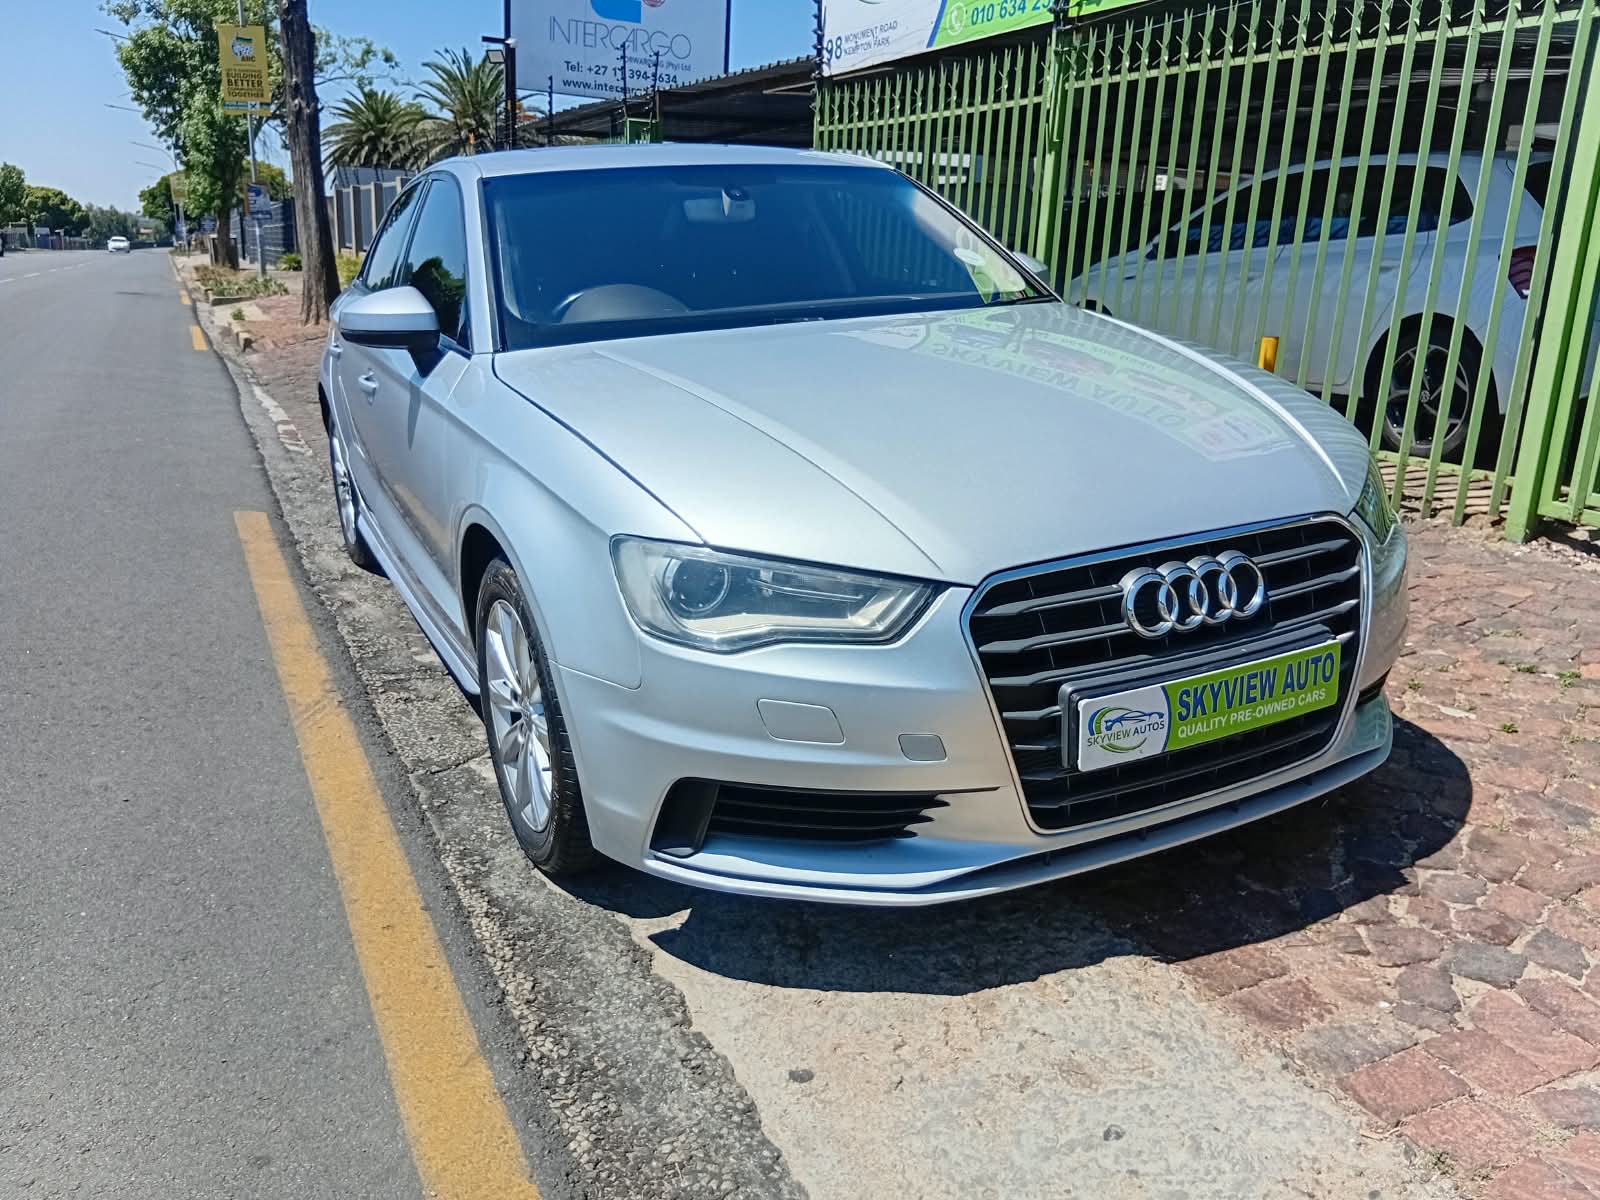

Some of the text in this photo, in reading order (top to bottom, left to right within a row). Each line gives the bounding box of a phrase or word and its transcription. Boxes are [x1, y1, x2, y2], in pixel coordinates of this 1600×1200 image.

[971, 3, 995, 26] 010
[1000, 0, 1027, 19] 634
[549, 15, 692, 60] INTERCARGO
[845, 20, 898, 43] MONUMENT ROAD
[826, 35, 843, 62] 98
[844, 36, 890, 55] KEMPTON PARK
[226, 70, 262, 80] BUILDING
[564, 60, 583, 73] Tel:
[587, 64, 608, 76] +27
[227, 79, 263, 88] BETTER
[1177, 651, 1335, 722] SKYVIEW AUTO
[1178, 688, 1326, 739] QUALITY PRE-OWNED CARS
[1087, 720, 1165, 747] SKYVIEW AUTOS
